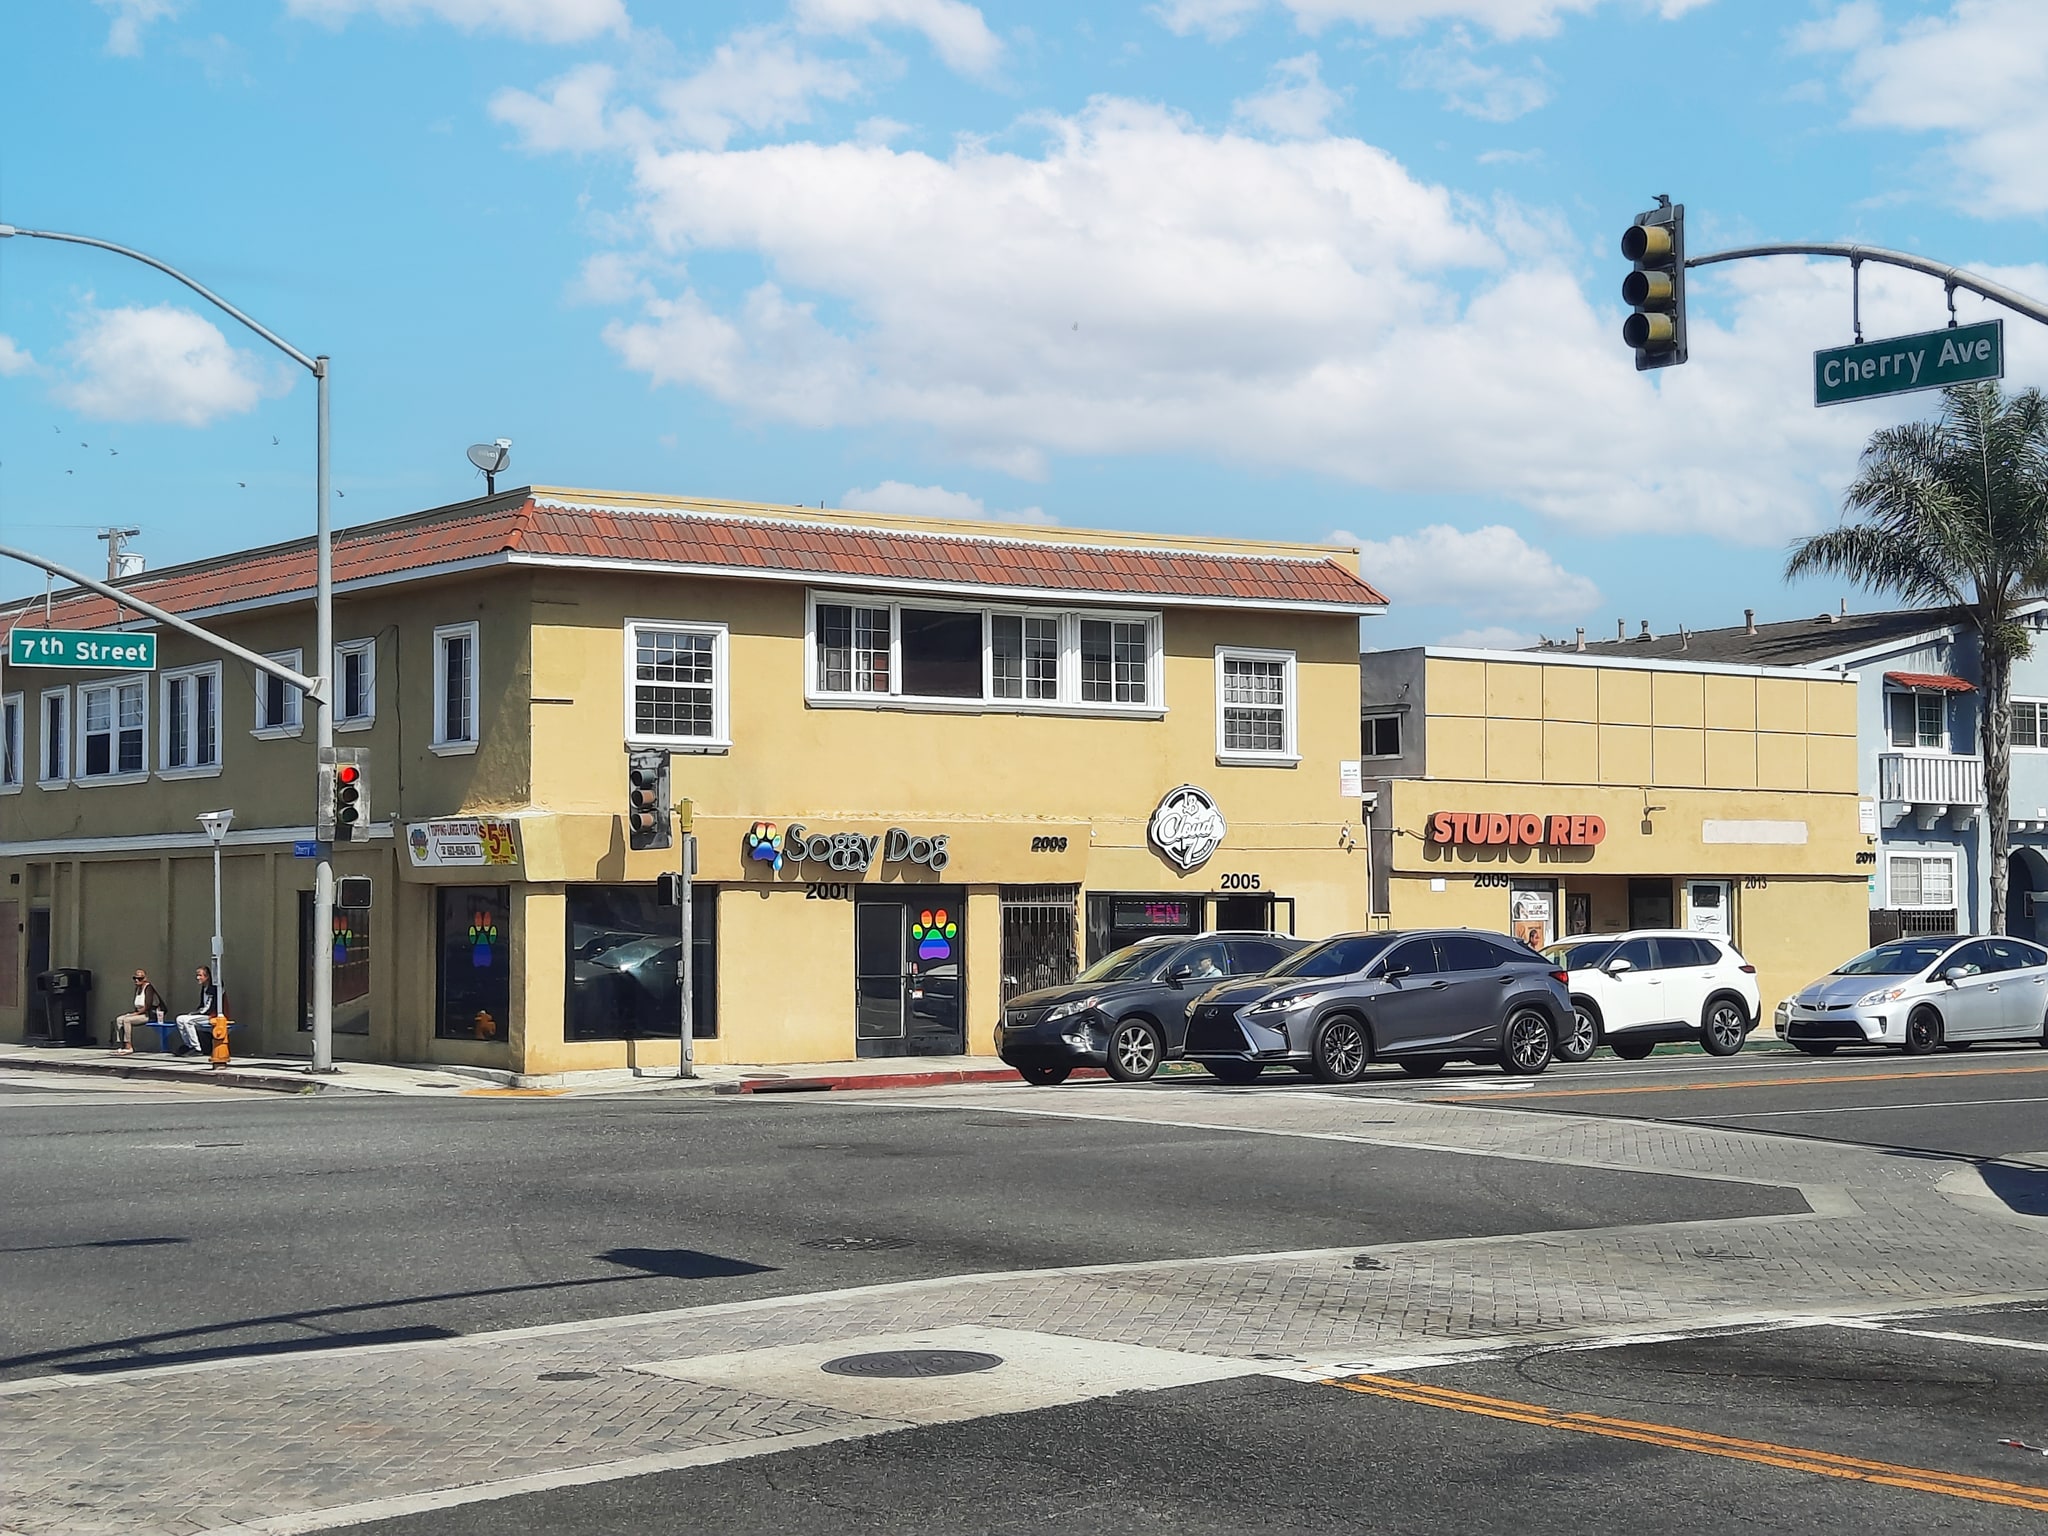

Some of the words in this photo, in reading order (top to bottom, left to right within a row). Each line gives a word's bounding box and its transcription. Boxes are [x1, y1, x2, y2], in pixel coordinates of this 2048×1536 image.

[1823, 350, 1926, 388] Cherry
[1937, 338, 1992, 368] Ave
[20, 636, 65, 659] 7th
[75, 641, 148, 661] Street
[1157, 812, 1217, 846] Cloud
[1433, 811, 1543, 845] STUDIO
[1549, 815, 1607, 846] RED
[785, 823, 882, 873] Soggy
[885, 827, 951, 872] Dog
[1031, 836, 1068, 852] 2003
[1220, 873, 1261, 890] 2005
[1473, 873, 1509, 888] 2009
[1744, 876, 1768, 890] 2013
[805, 883, 852, 900] 2001
